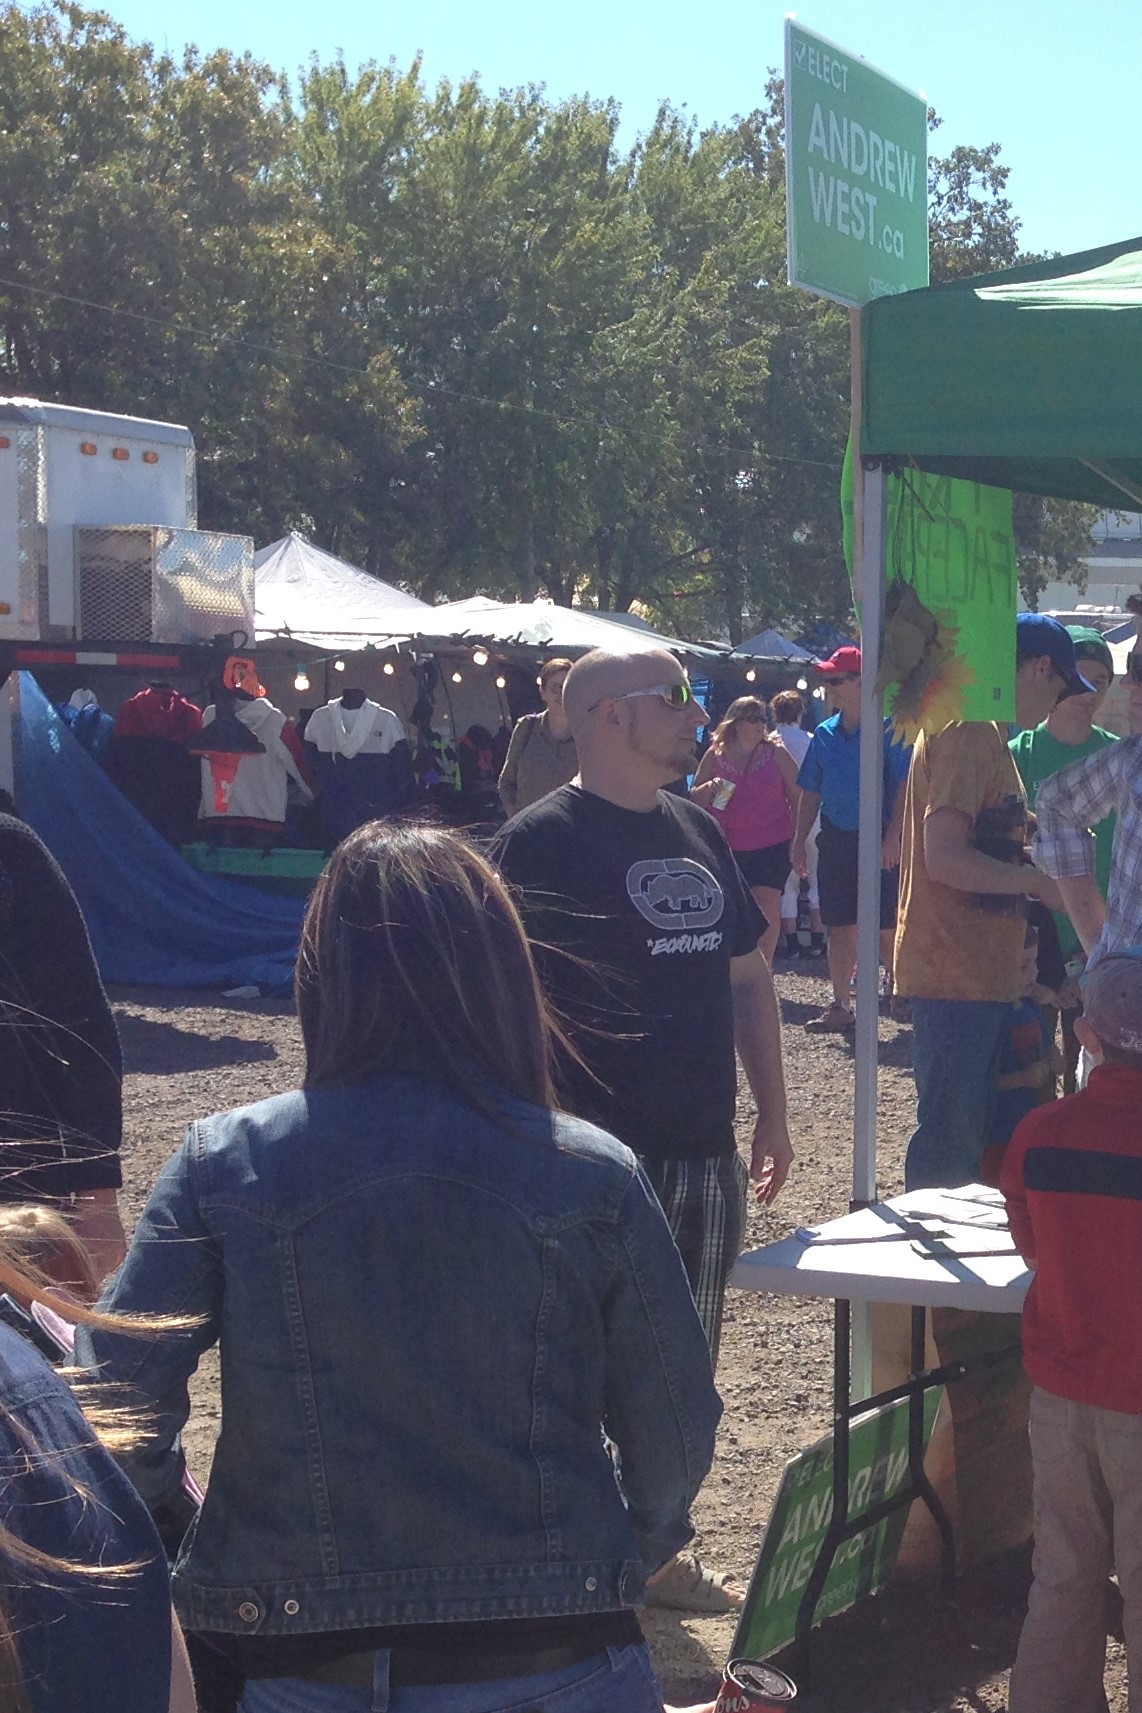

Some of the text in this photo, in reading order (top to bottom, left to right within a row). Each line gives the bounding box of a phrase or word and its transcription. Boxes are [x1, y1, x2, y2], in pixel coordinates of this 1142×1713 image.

[807, 102, 917, 203] ANDREW
[807, 166, 904, 260] WEST.ca
[775, 1445, 910, 1555] ANREW
